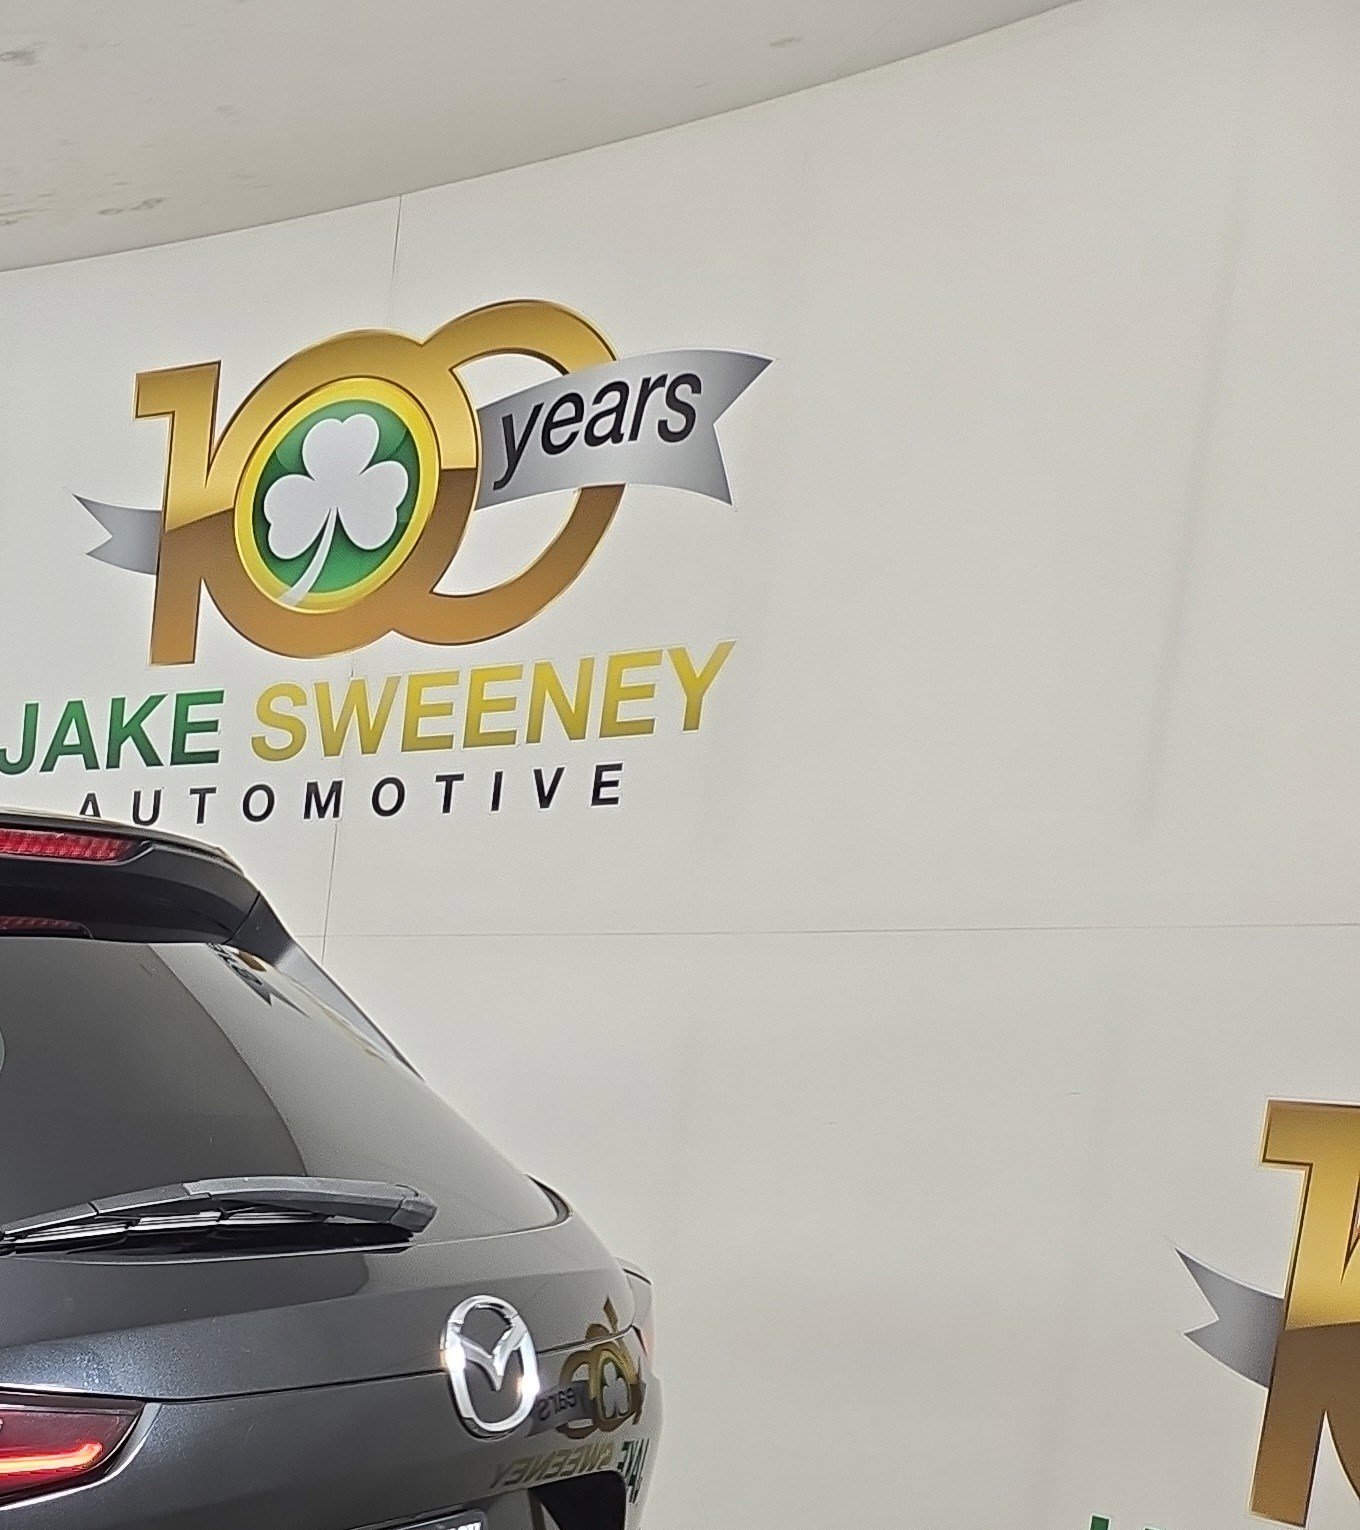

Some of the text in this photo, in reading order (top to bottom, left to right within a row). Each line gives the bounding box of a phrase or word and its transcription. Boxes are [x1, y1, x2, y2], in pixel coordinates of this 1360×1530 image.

[493, 371, 703, 491] years
[252, 640, 737, 762] SWEENEY
[79, 763, 625, 826] AUTOMOTIVE
